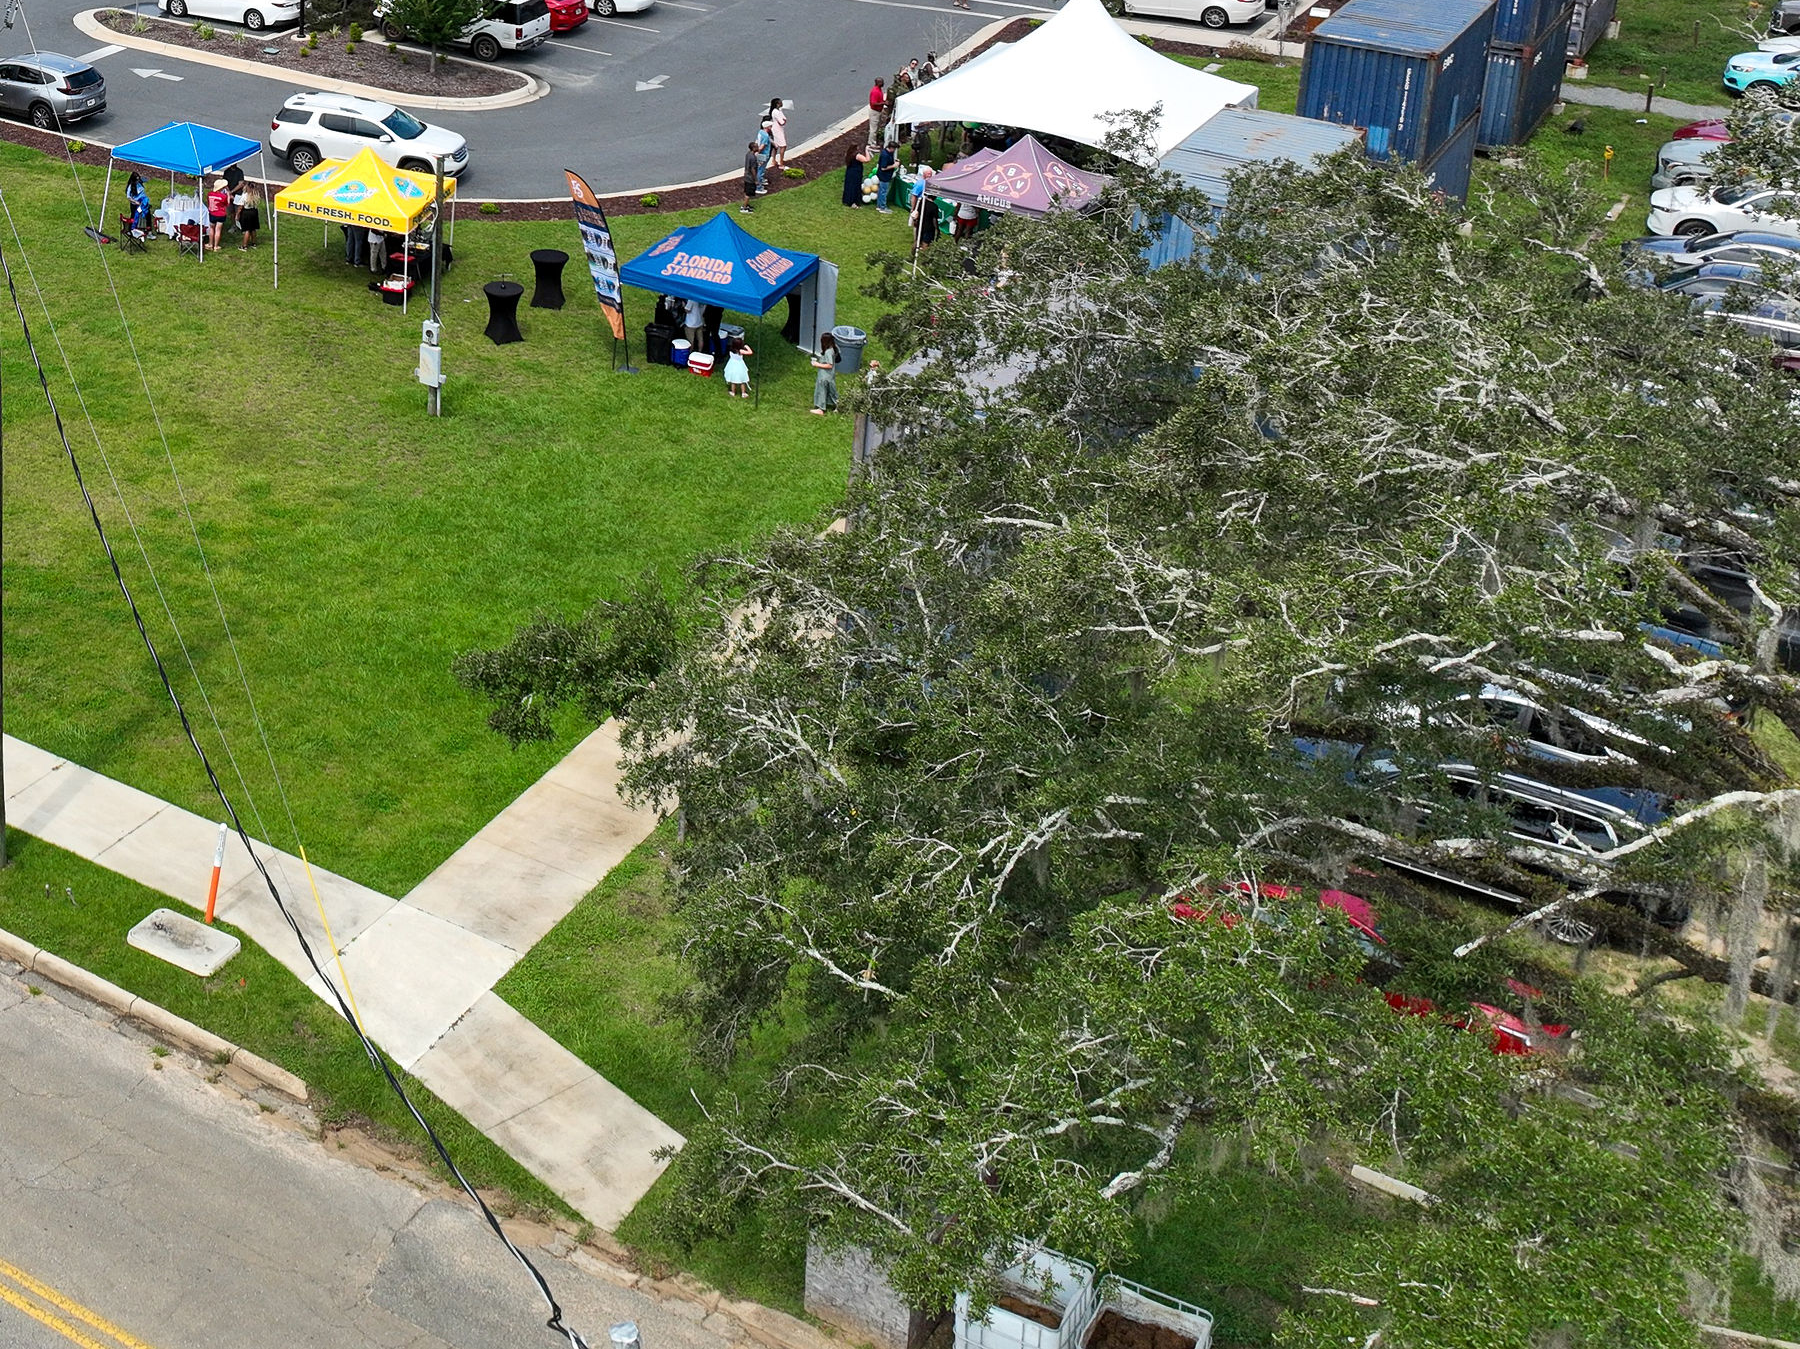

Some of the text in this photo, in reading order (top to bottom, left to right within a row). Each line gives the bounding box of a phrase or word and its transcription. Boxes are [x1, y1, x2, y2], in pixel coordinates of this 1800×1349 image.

[976, 194, 1012, 209] AMICUS
[288, 201, 393, 228] FUN. FRESH. FOOD.
[673, 251, 734, 274] FLORIDA
[746, 249, 780, 272] FLORIDA
[758, 257, 794, 286] STANDARD
[661, 263, 732, 285] STANDARD
